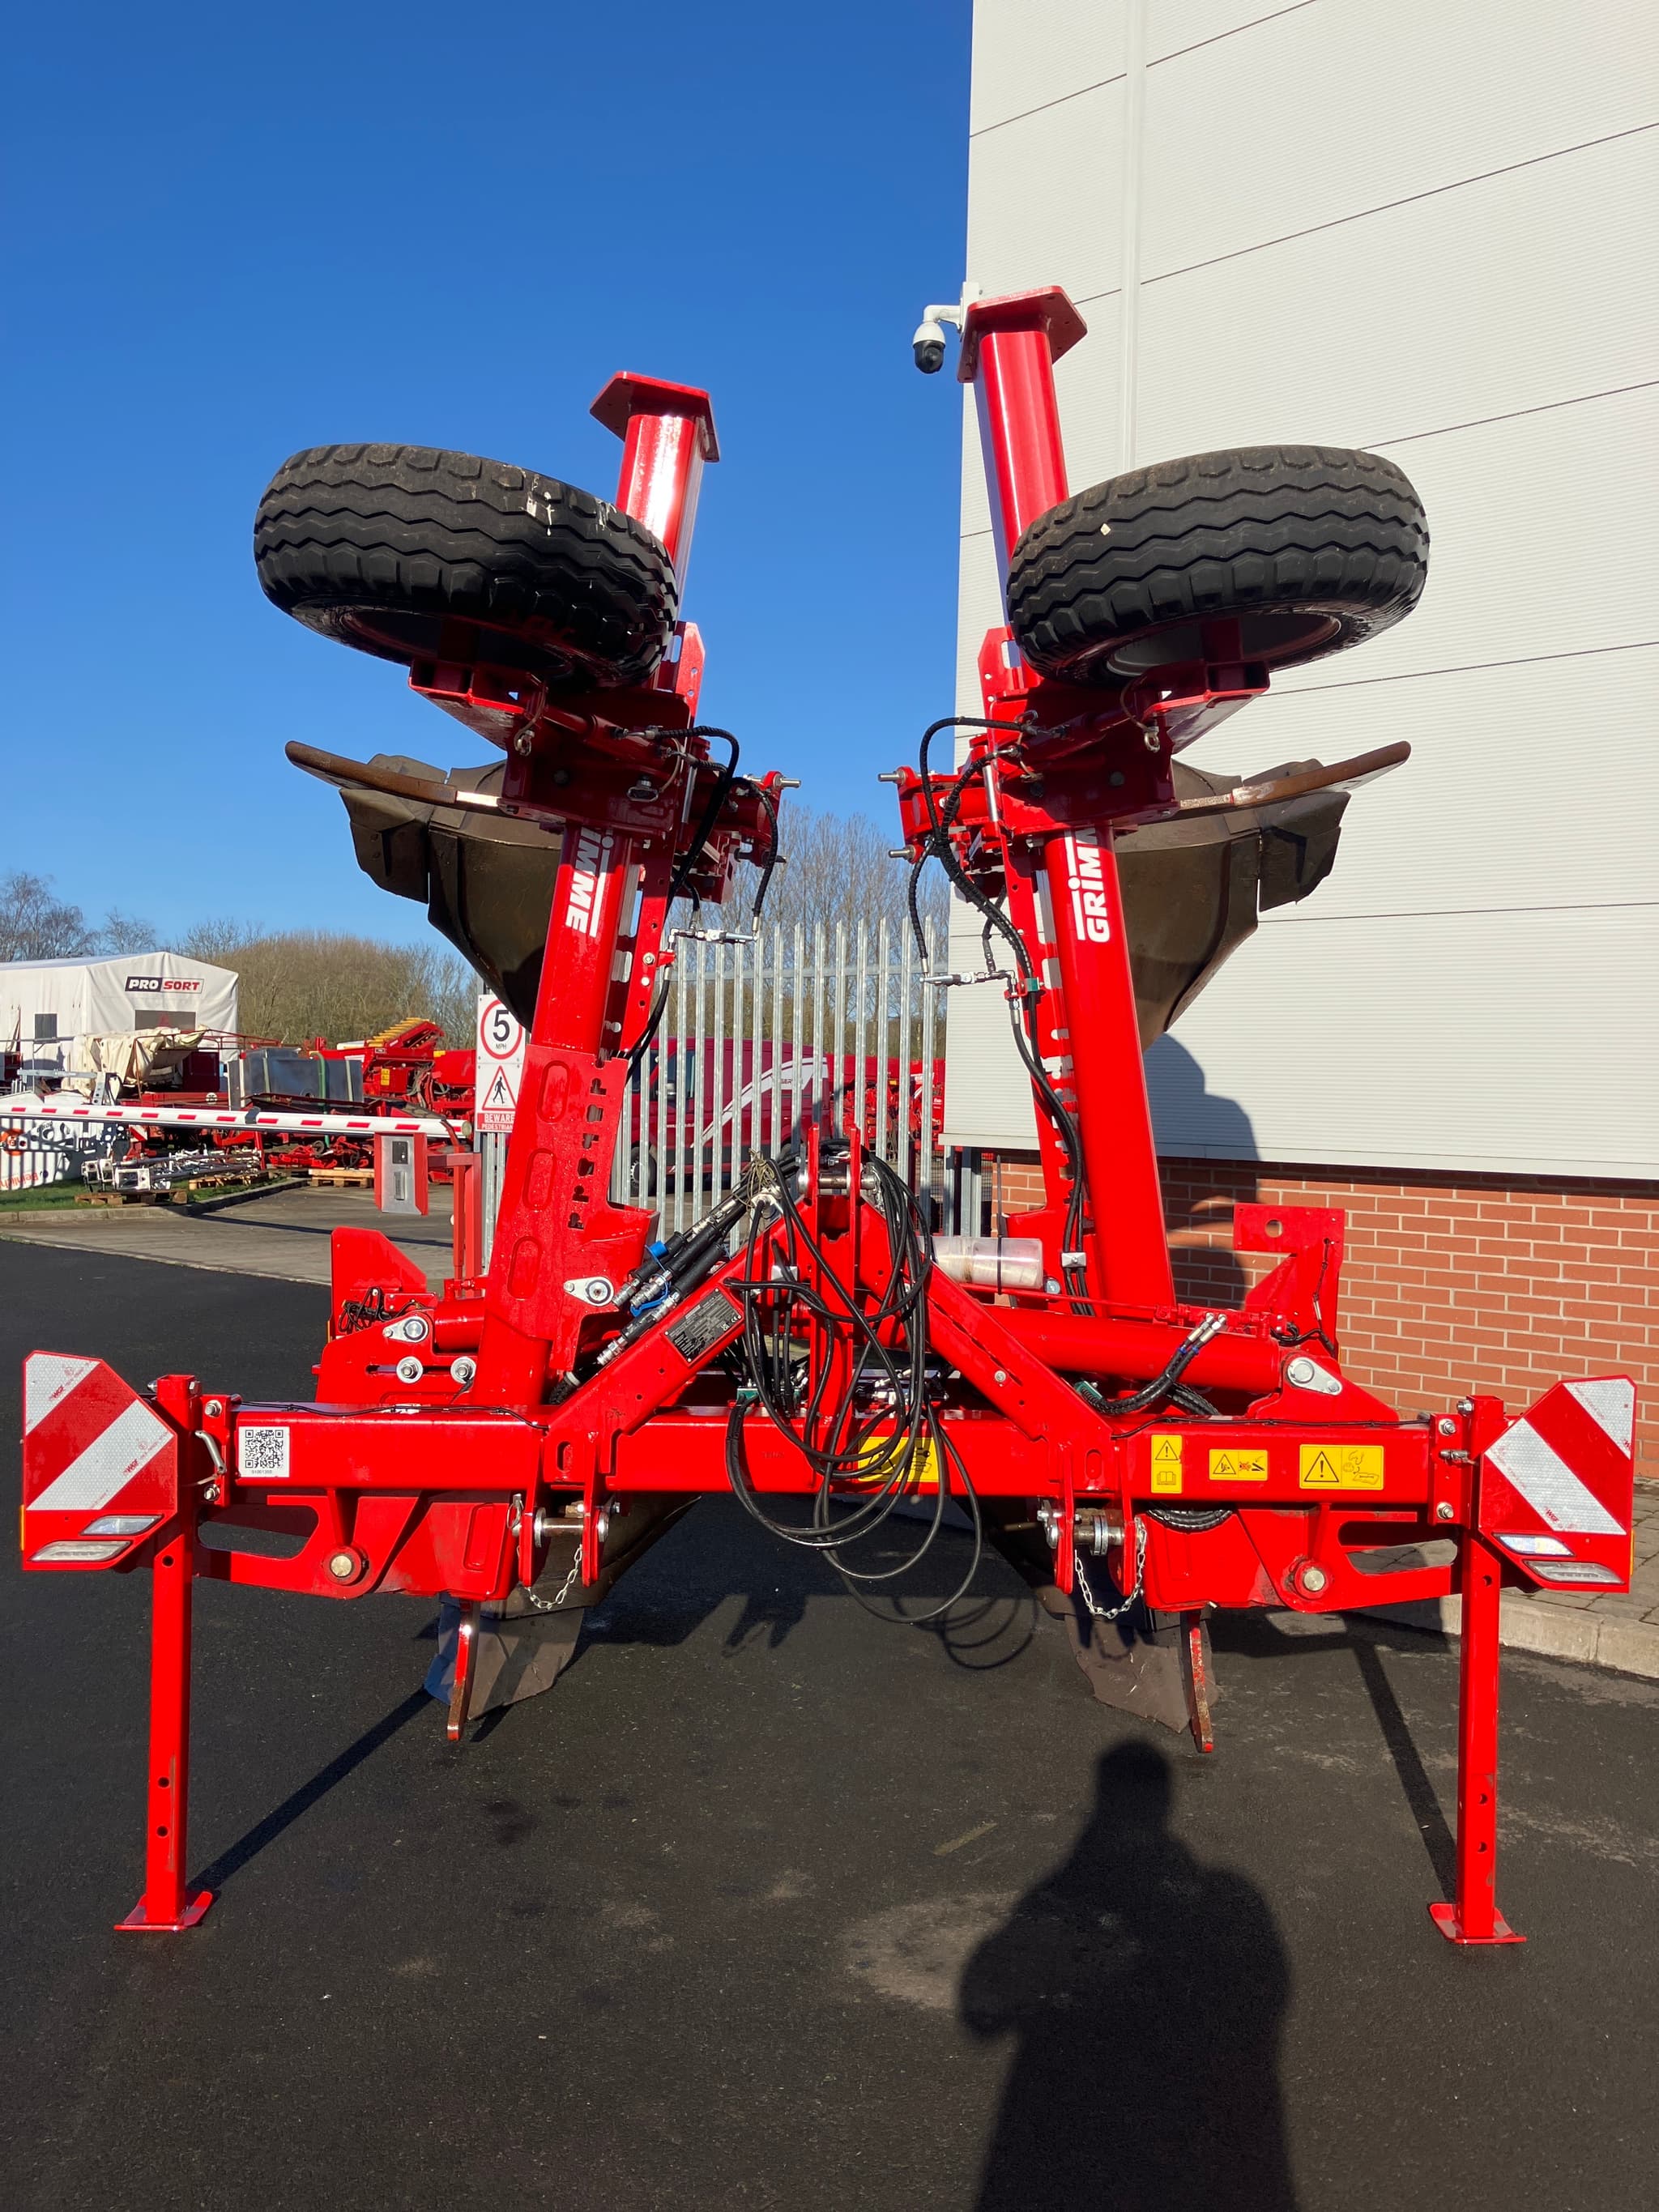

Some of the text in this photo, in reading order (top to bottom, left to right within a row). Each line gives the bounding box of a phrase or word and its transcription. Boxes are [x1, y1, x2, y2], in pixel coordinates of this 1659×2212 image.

[128, 978, 200, 991] PRO SORT
[493, 1009, 510, 1042] 5
[484, 1113, 515, 1123] BEWARE
